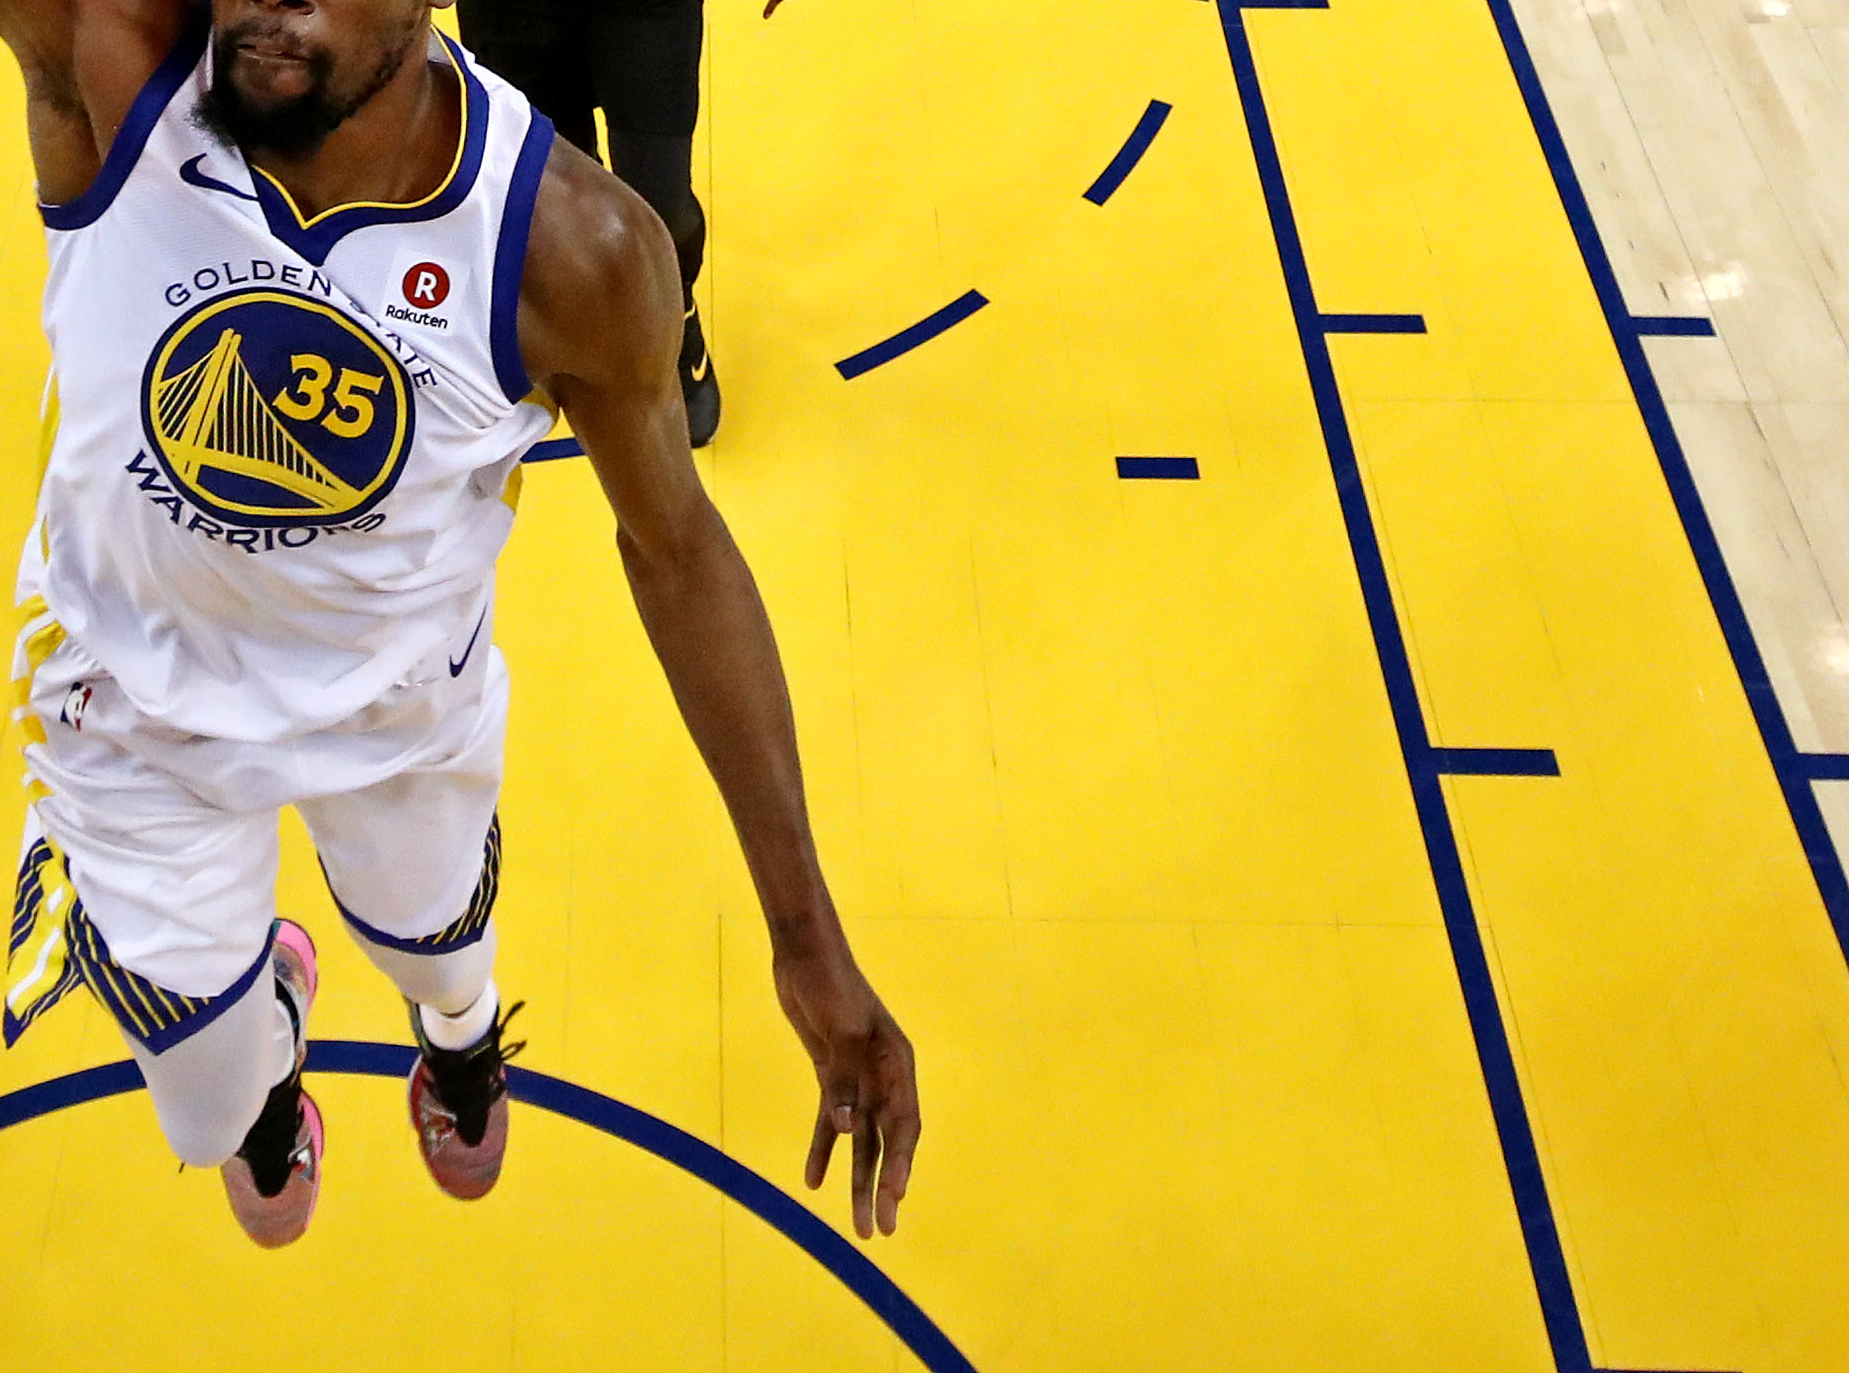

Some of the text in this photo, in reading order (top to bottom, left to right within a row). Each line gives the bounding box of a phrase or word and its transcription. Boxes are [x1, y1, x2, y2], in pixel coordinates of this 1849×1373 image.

[165, 259, 332, 308] GOLDEN
[385, 304, 449, 330] Rakuten
[272, 353, 384, 438] 35
